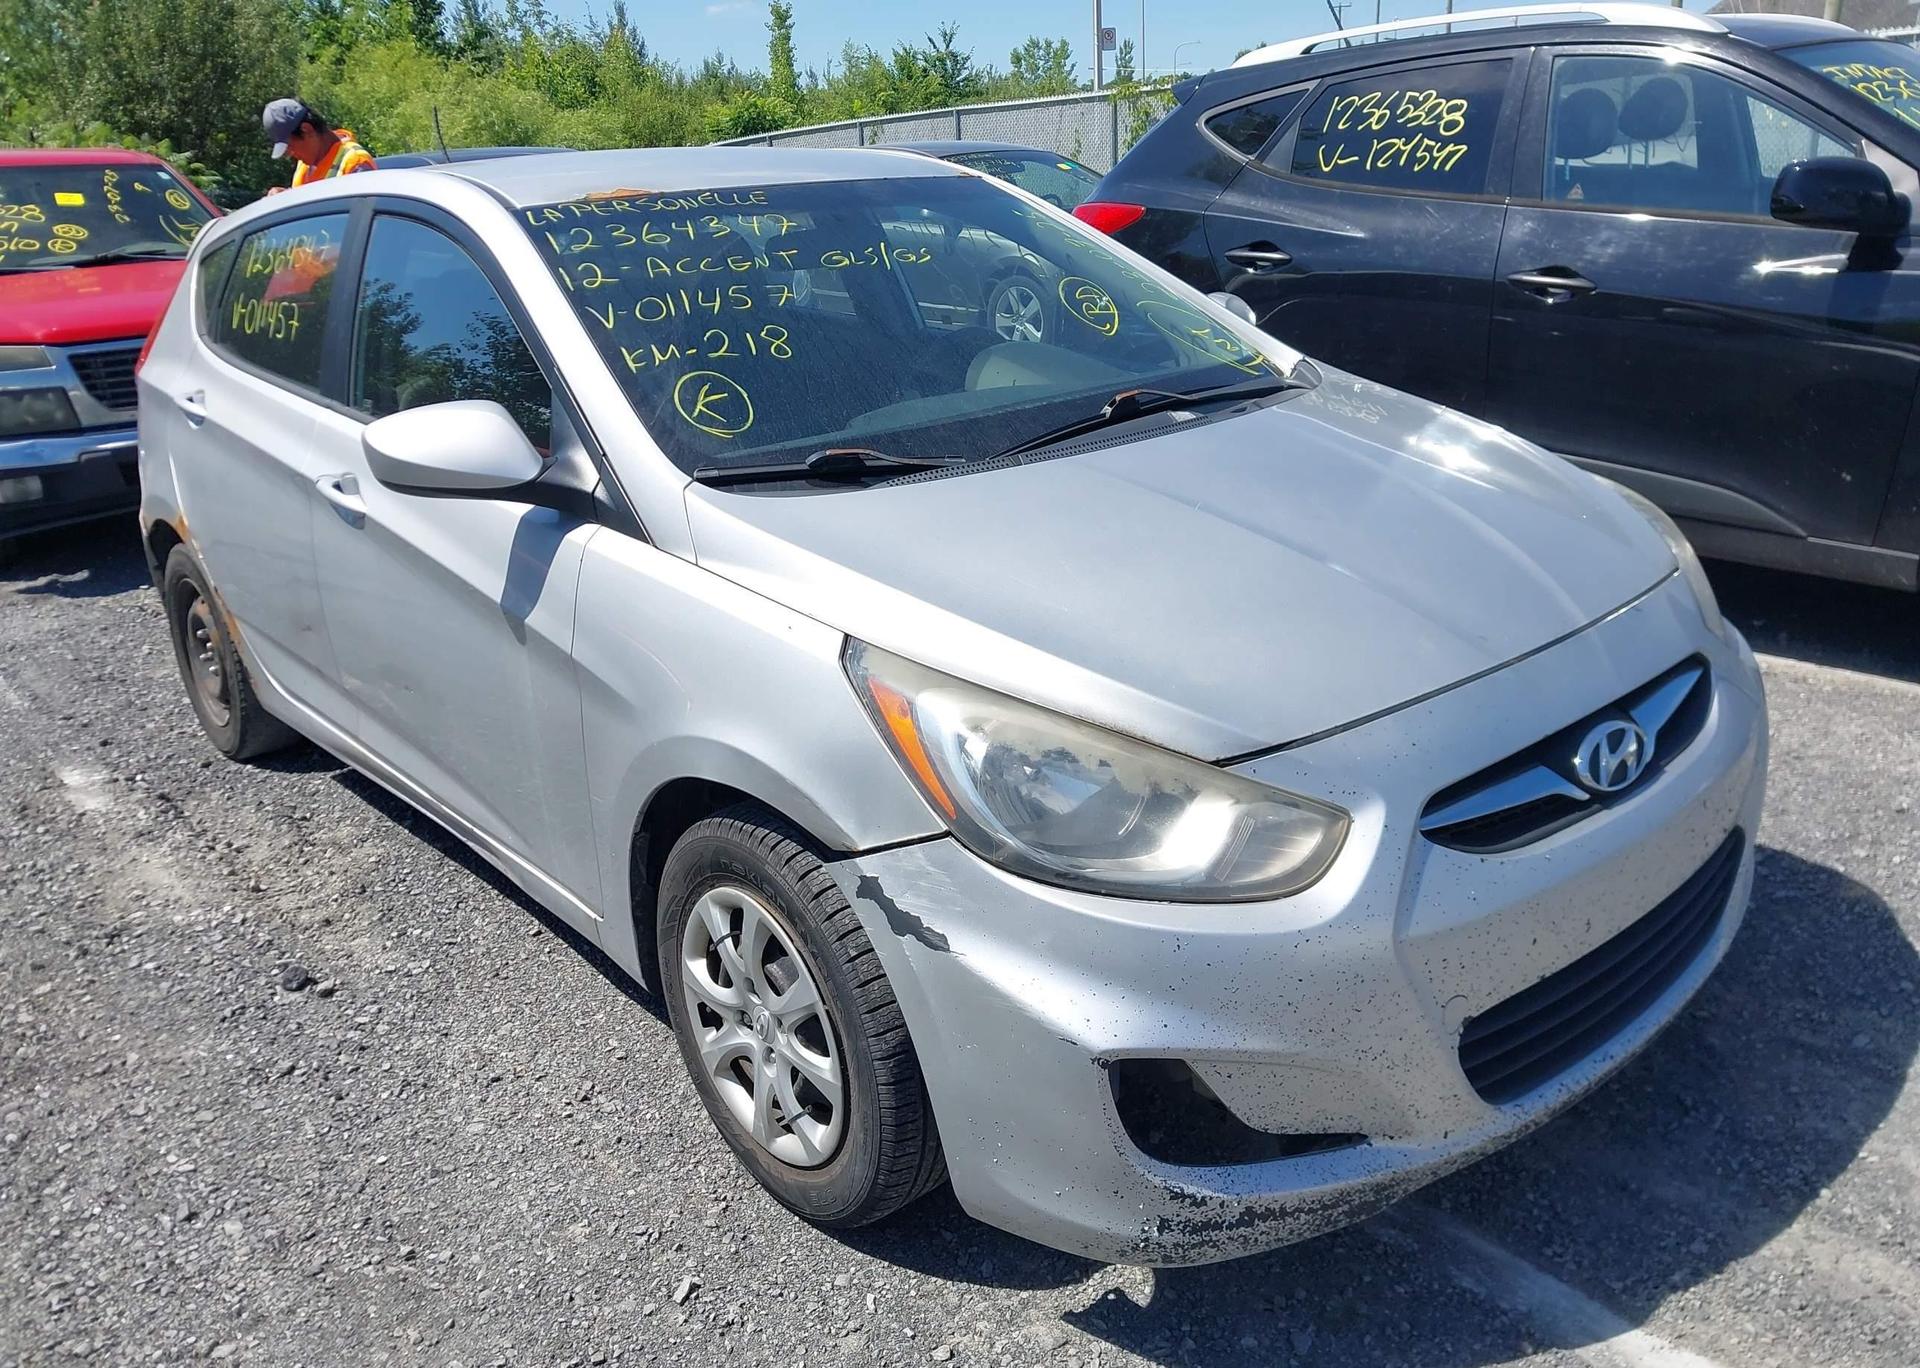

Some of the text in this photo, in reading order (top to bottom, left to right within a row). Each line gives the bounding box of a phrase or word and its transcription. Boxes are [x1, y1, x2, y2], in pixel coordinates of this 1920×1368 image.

[1321, 89, 1468, 137] 12365328
[544, 213, 798, 256] 12364347
[820, 241, 932, 271] GLS/GS
[232, 292, 300, 342] V-011457
[585, 283, 795, 330] V-011457
[619, 324, 793, 373] KM-218
